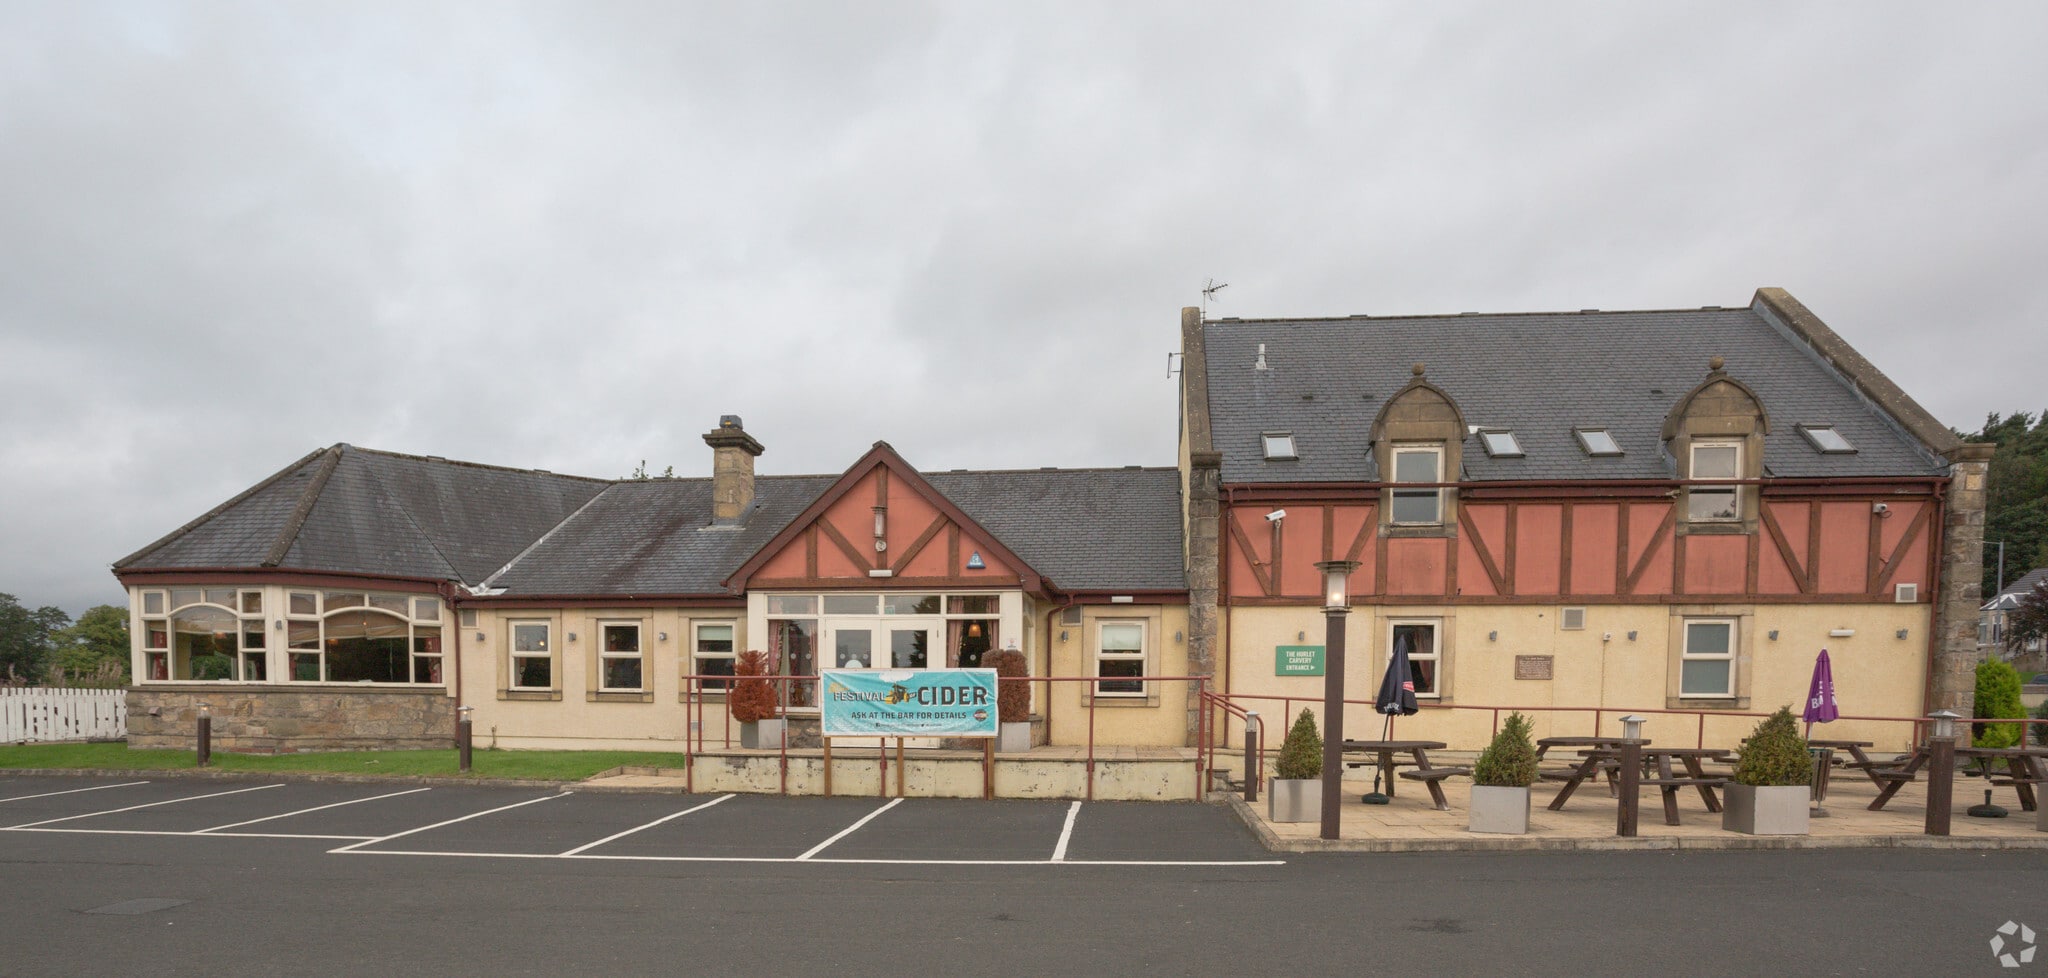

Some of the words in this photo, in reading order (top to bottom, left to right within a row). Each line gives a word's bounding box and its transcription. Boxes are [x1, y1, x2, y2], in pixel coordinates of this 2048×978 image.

[834, 692, 886, 702] FESTIVAL
[917, 686, 988, 706] CIDER
[851, 711, 867, 720] ASK
[868, 711, 879, 720] AT
[881, 711, 896, 720] THE
[897, 711, 914, 720] BAR
[916, 711, 932, 720] FOR
[934, 711, 967, 720] DETAILS
